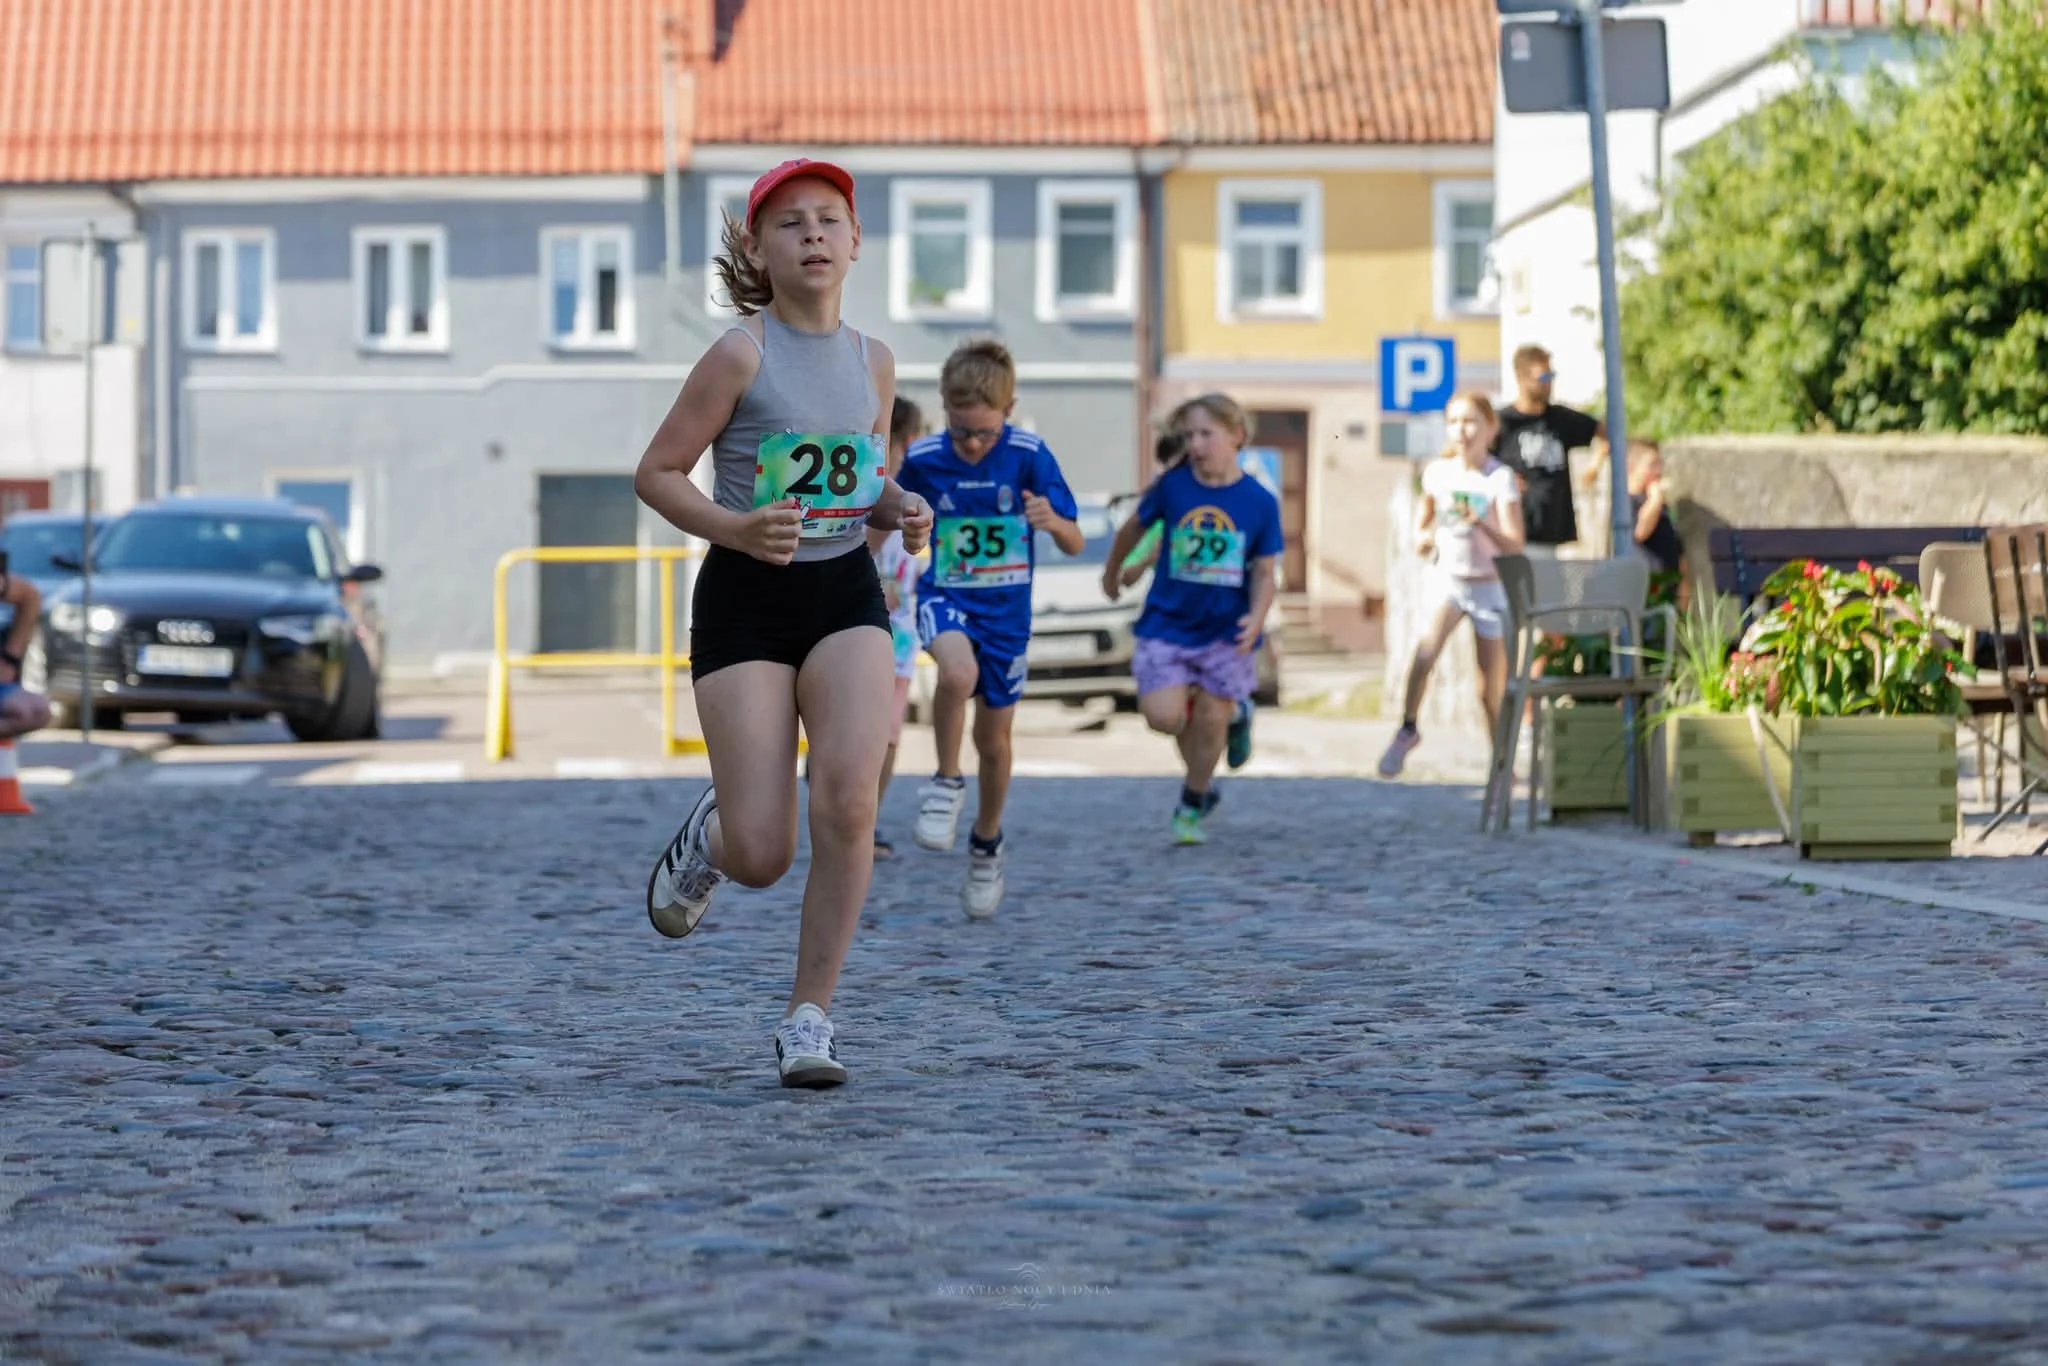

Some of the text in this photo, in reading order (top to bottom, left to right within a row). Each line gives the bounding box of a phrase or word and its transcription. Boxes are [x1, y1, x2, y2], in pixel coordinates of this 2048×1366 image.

[1393, 340, 1444, 409] P
[785, 443, 858, 496] 28
[957, 524, 1006, 558] 35
[1187, 534, 1227, 562] 29
